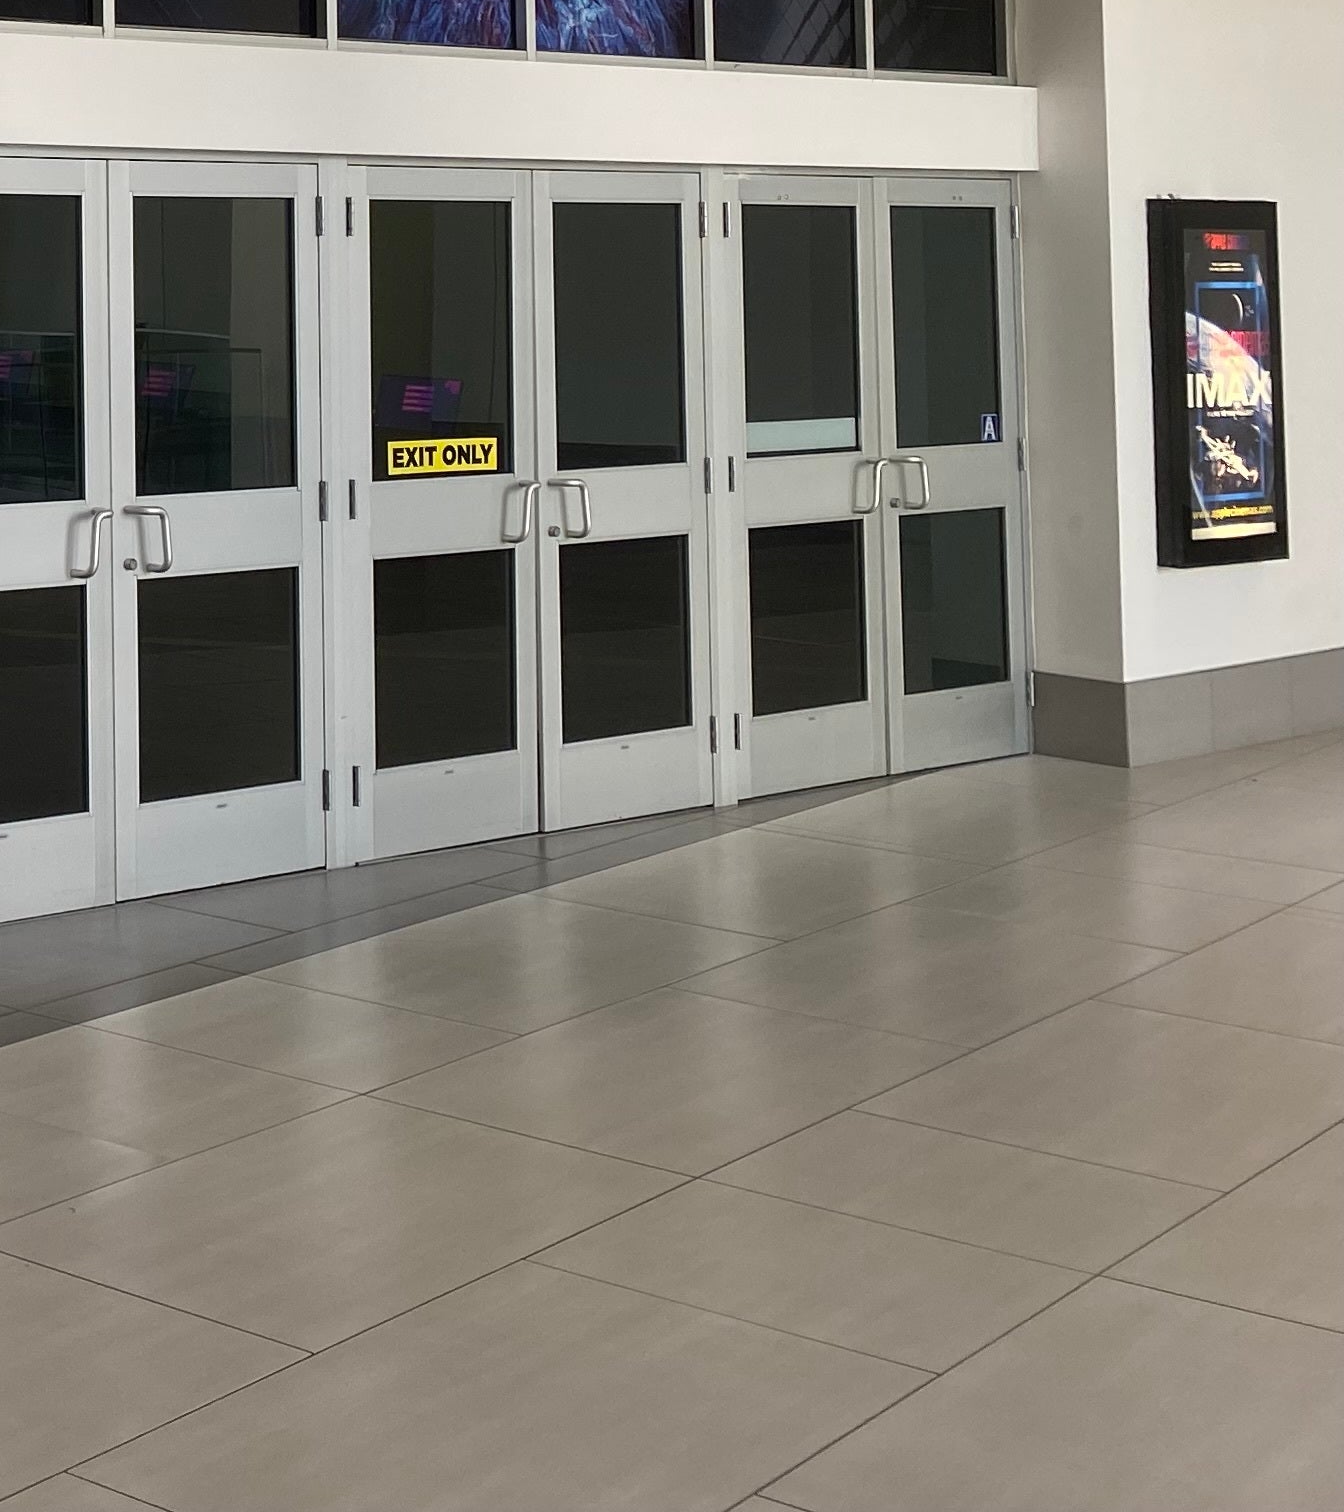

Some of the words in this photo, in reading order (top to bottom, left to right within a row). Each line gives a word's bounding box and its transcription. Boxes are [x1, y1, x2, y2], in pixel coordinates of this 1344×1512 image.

[1187, 372, 1272, 409] IMAX
[393, 445, 437, 468] EXIT
[442, 444, 494, 466] ONLY
